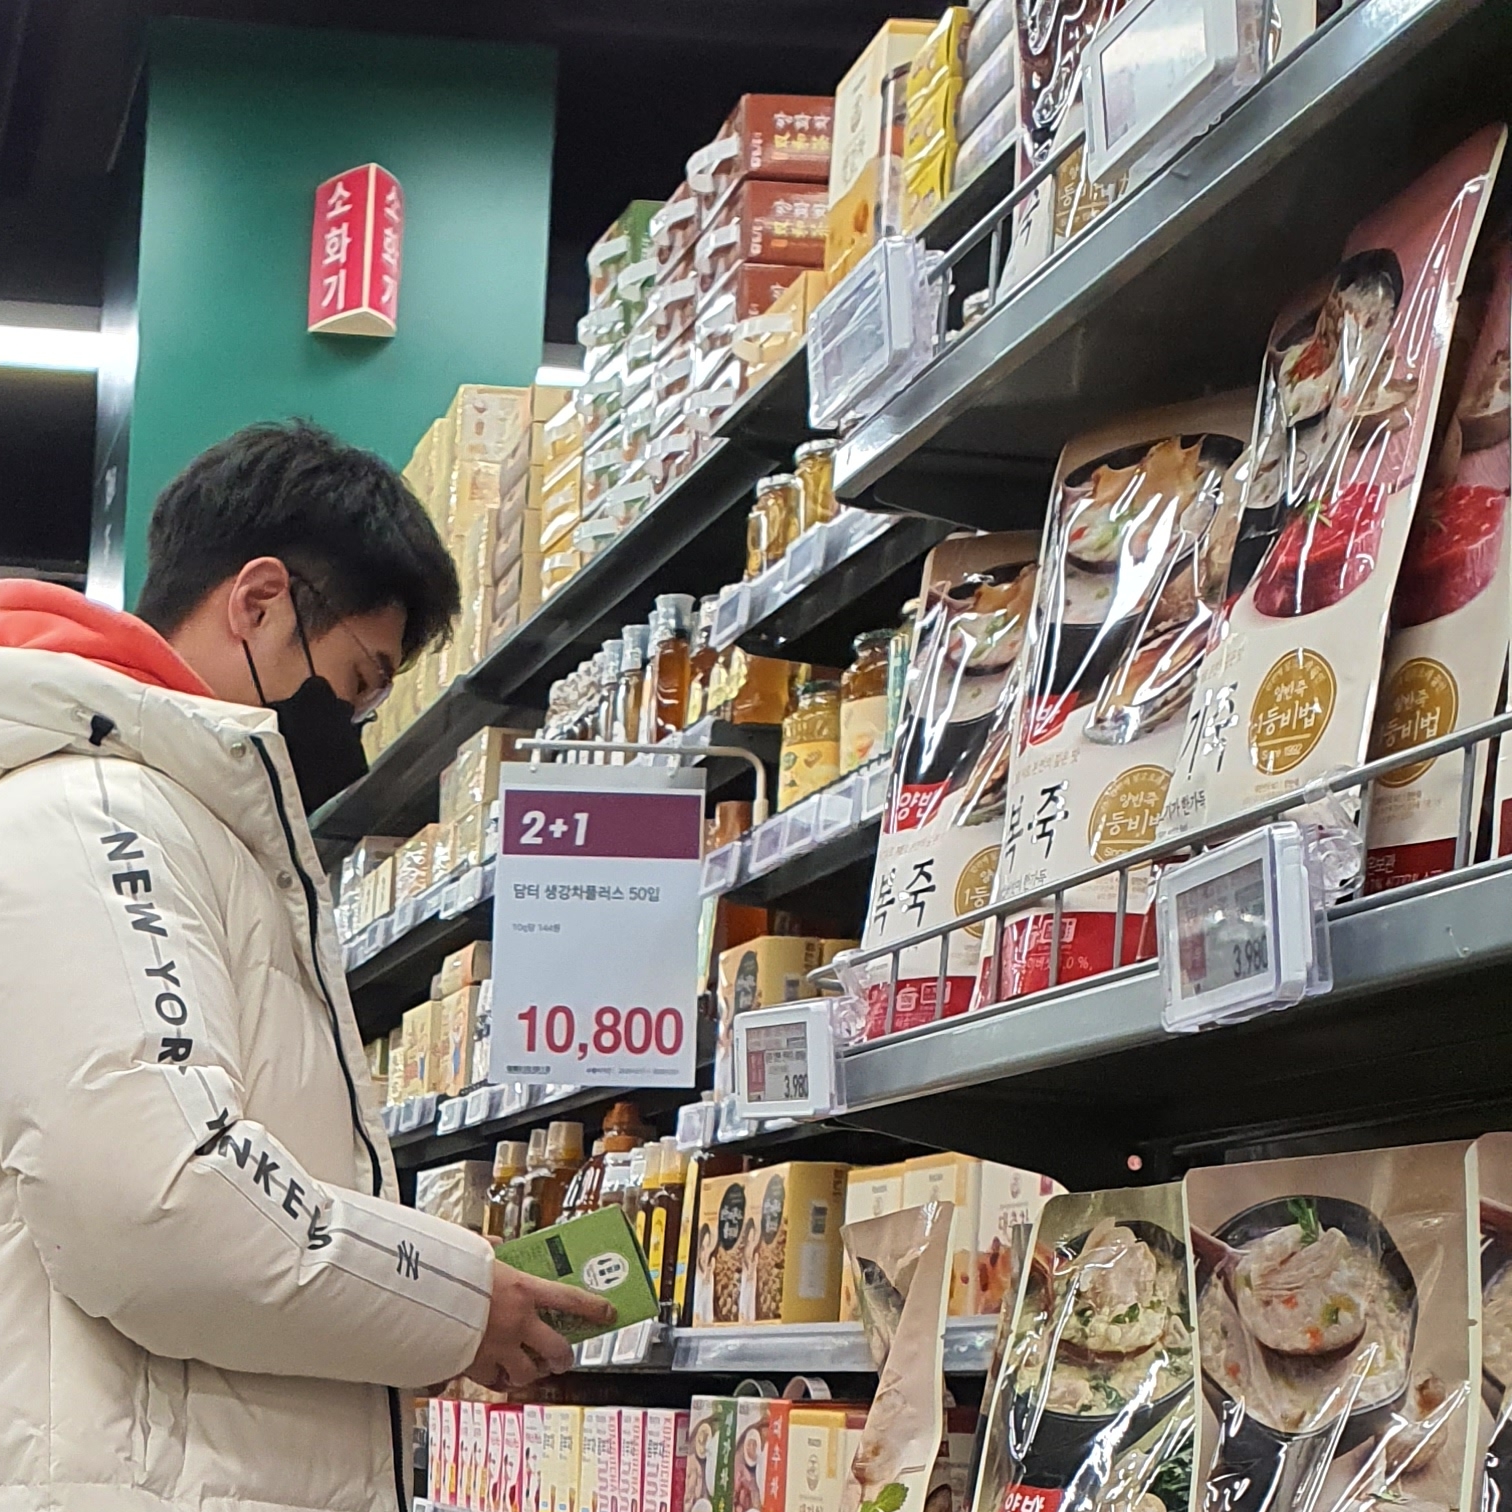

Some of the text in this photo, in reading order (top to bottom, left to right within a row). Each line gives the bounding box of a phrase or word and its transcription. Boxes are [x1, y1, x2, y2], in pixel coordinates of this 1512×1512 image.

[321, 180, 353, 310] 소화기
[519, 810, 589, 846] 2+1
[513, 883, 661, 903] 담터 생강차플러스 50입
[100, 831, 168, 938] NEW
[144, 959, 193, 1075] YOR
[517, 1004, 684, 1061] 10,800
